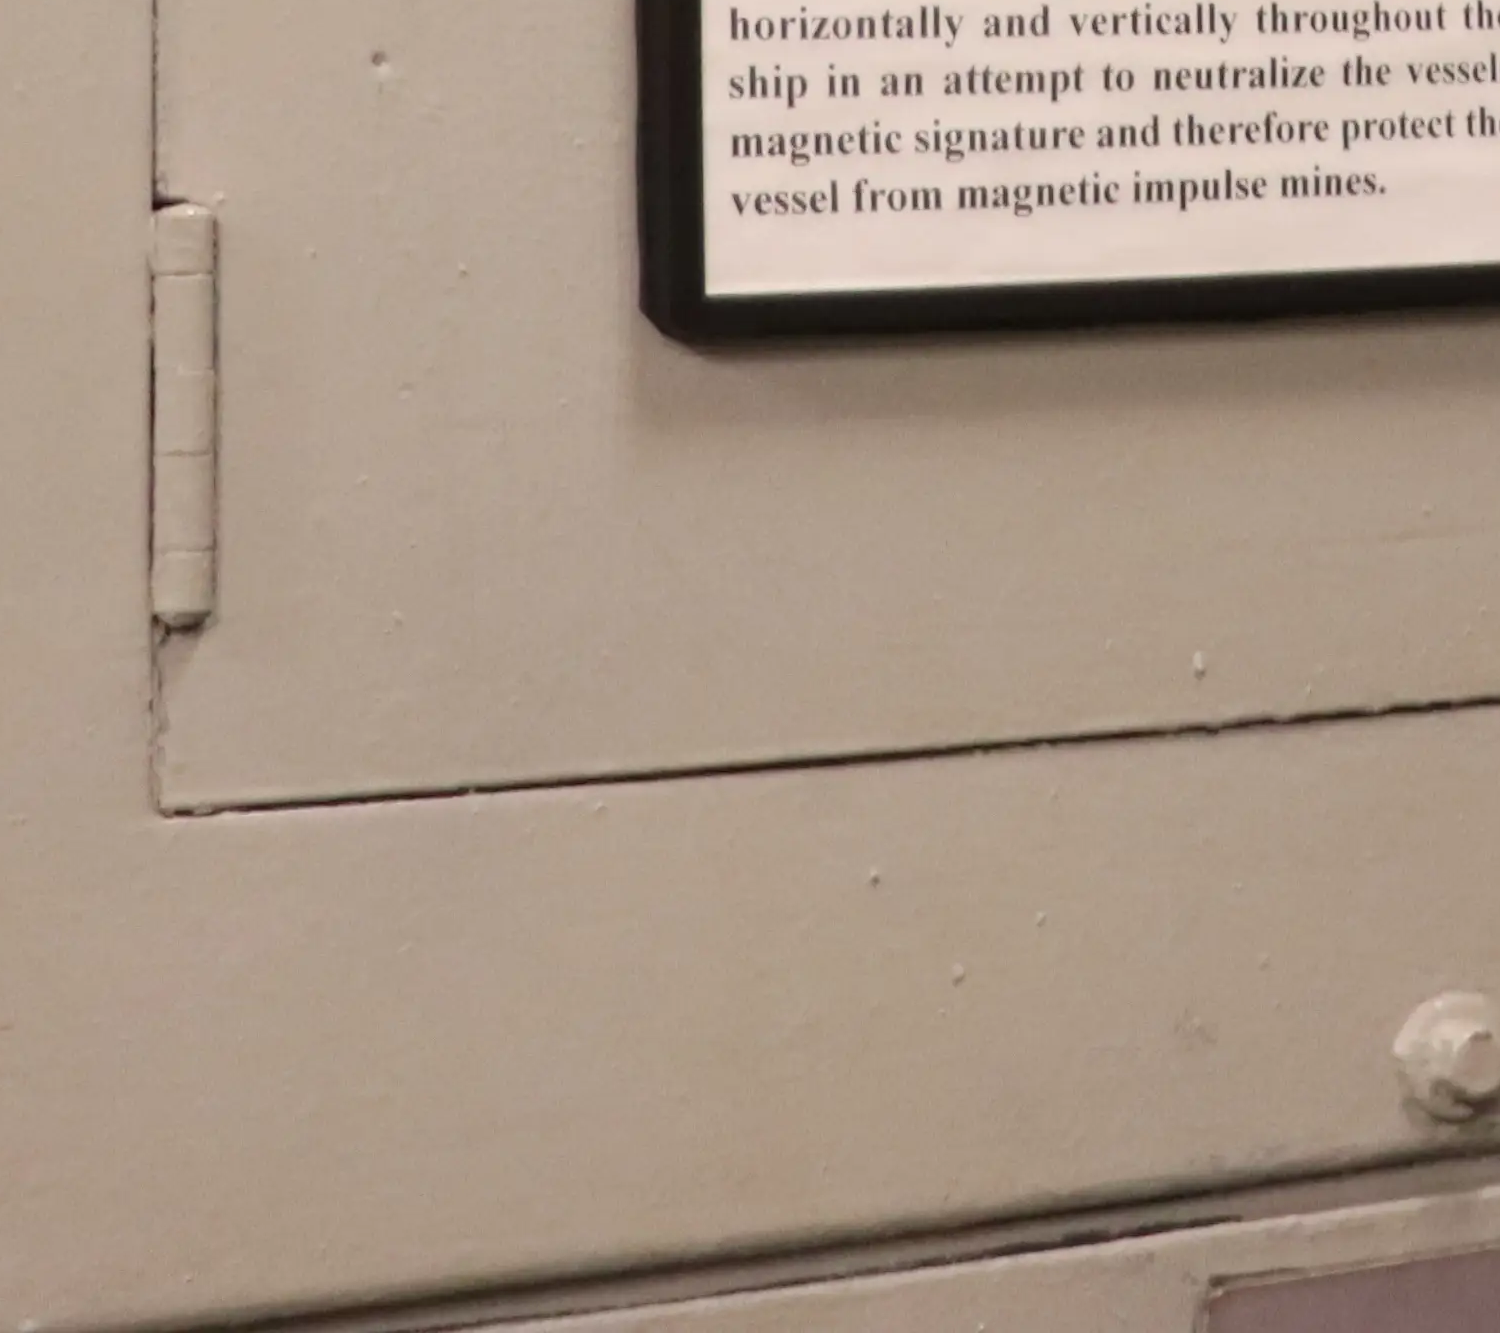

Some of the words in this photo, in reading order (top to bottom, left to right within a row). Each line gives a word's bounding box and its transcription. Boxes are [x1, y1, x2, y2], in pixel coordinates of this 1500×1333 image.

[730, 6, 963, 48] horizontally
[984, 4, 1050, 38] and
[1070, 2, 1237, 43] vertically
[1257, 0, 1446, 41] throughout
[728, 65, 808, 109] ship
[828, 64, 860, 97] in
[880, 71, 923, 96] an
[944, 62, 1084, 103] attempt
[1103, 63, 1134, 92] to
[1153, 56, 1325, 91] neutralize
[1342, 55, 1391, 86] the
[731, 120, 902, 166] magnetic
[914, 119, 1085, 162] signature
[1097, 116, 1159, 149] and
[1174, 112, 1329, 146] therefore
[1342, 109, 1456, 150] protect
[732, 179, 838, 216] vessel
[853, 178, 942, 212] from
[957, 171, 1120, 217] magnetic
[1133, 168, 1267, 211] impulse
[1281, 164, 1387, 196] mines.
